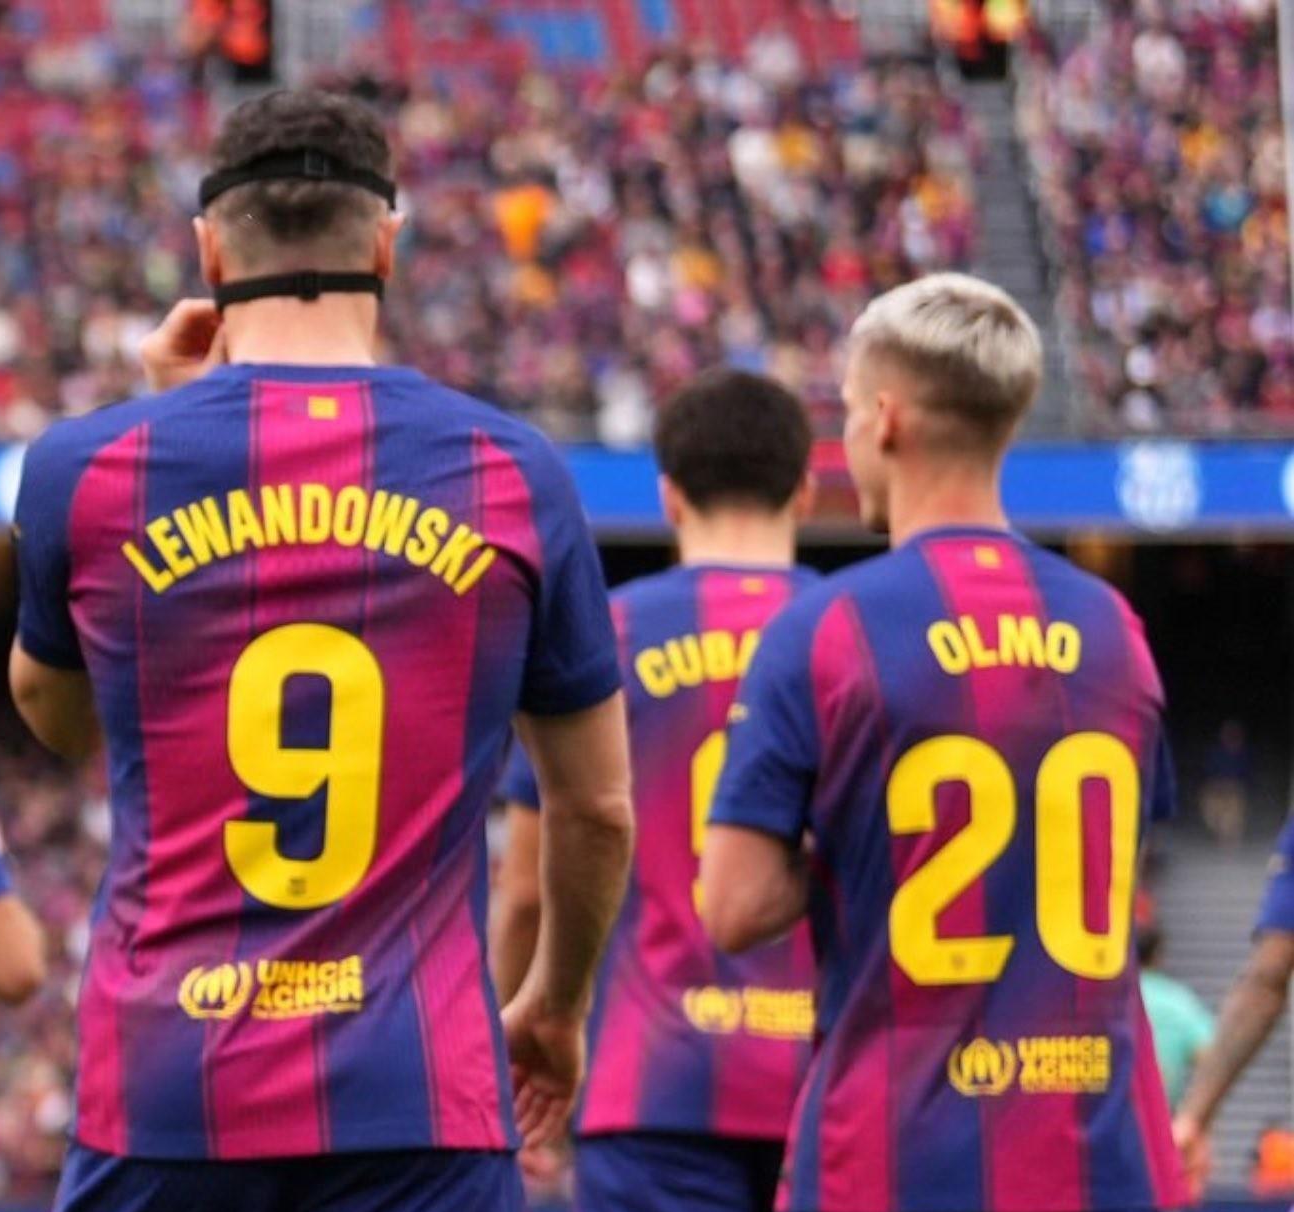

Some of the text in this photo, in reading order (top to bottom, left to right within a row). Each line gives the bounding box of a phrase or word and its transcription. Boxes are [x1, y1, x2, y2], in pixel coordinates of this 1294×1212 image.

[122, 484, 497, 595] LEWANDOWSKI
[927, 614, 1082, 675] OLMO
[223, 622, 385, 911] 9
[886, 731, 1140, 986] 20
